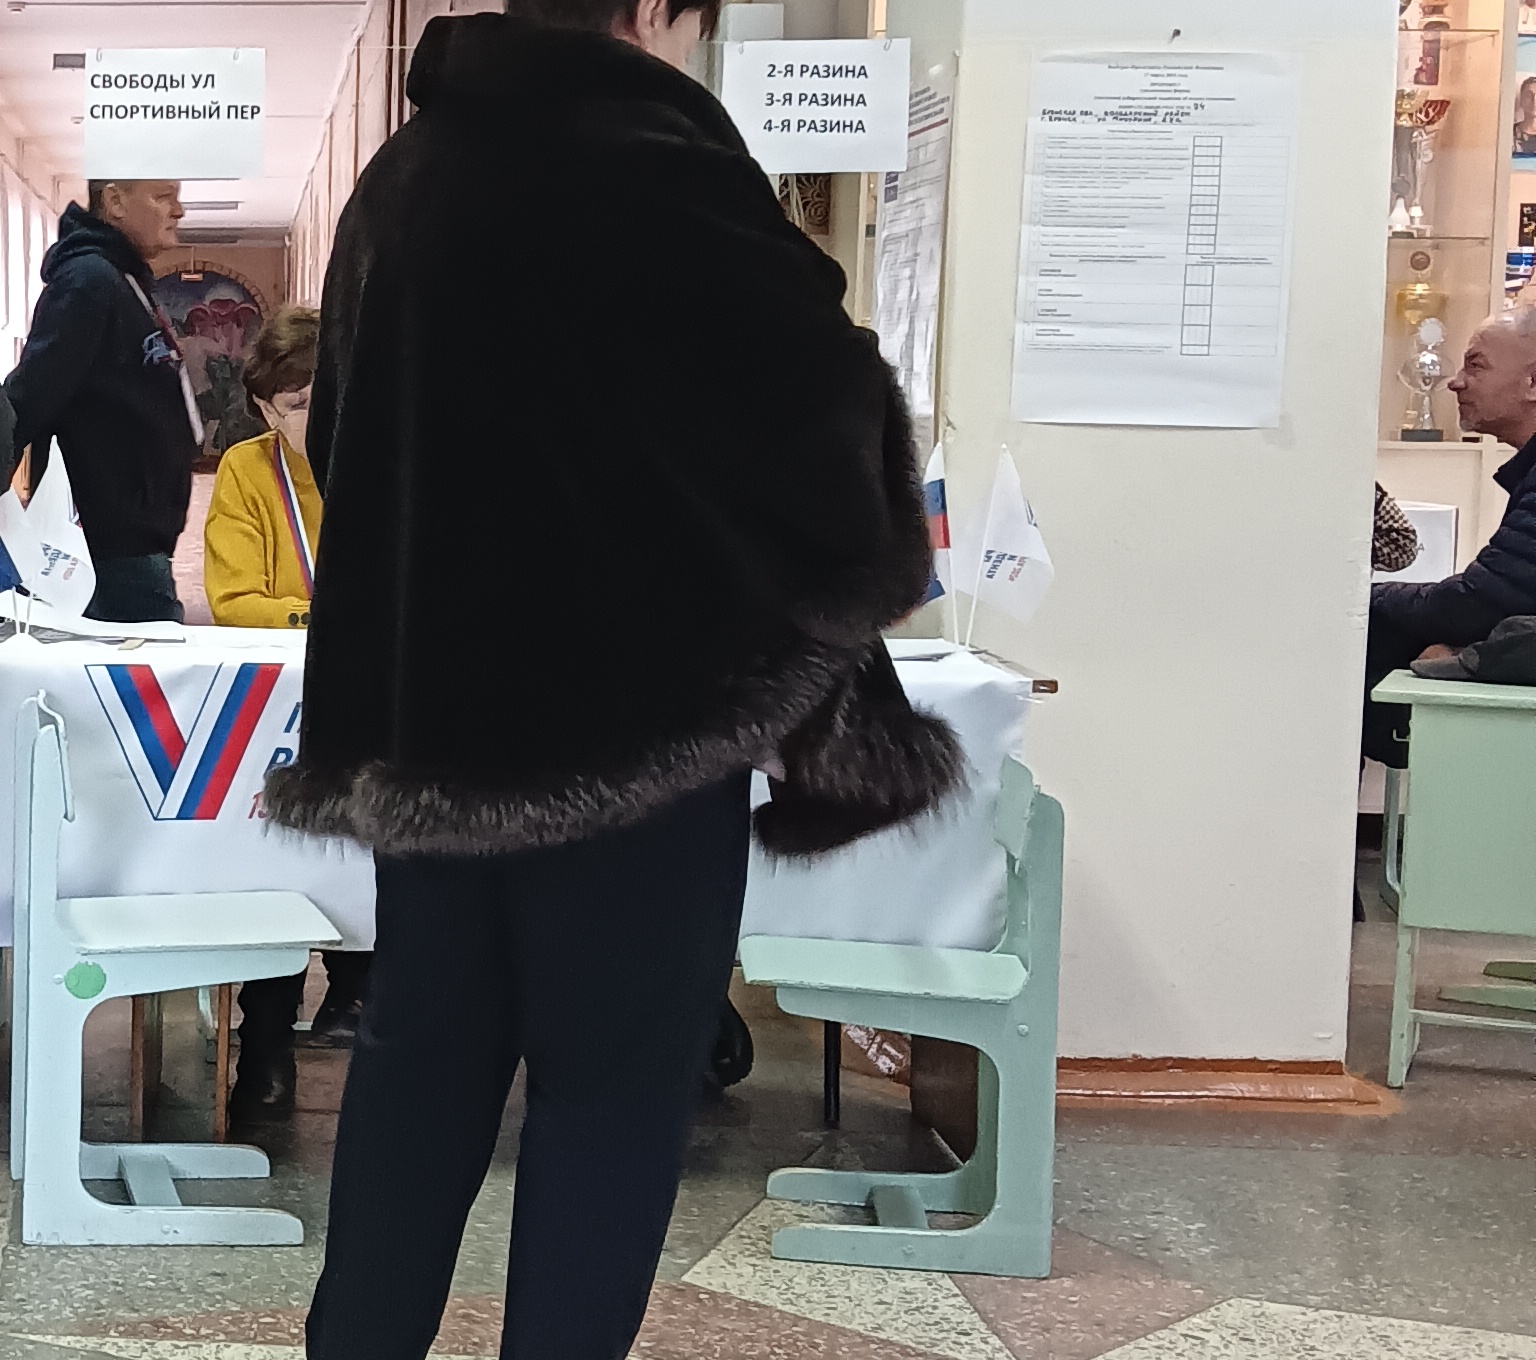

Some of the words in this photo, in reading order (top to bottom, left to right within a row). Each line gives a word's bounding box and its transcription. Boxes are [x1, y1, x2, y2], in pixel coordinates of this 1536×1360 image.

[767, 63, 794, 79] 2-Я
[799, 64, 869, 79] РАЗИНА
[90, 73, 186, 92] СВОБОДЫ
[191, 73, 215, 89] УЛ
[764, 92, 793, 107] 3-Я
[797, 92, 867, 108] РАЗИНА
[89, 100, 221, 120] СПОРТИВНЫЙ
[226, 104, 261, 120] ПЕР
[762, 119, 791, 133] 4-Я
[796, 119, 866, 134] РАЗИНА
